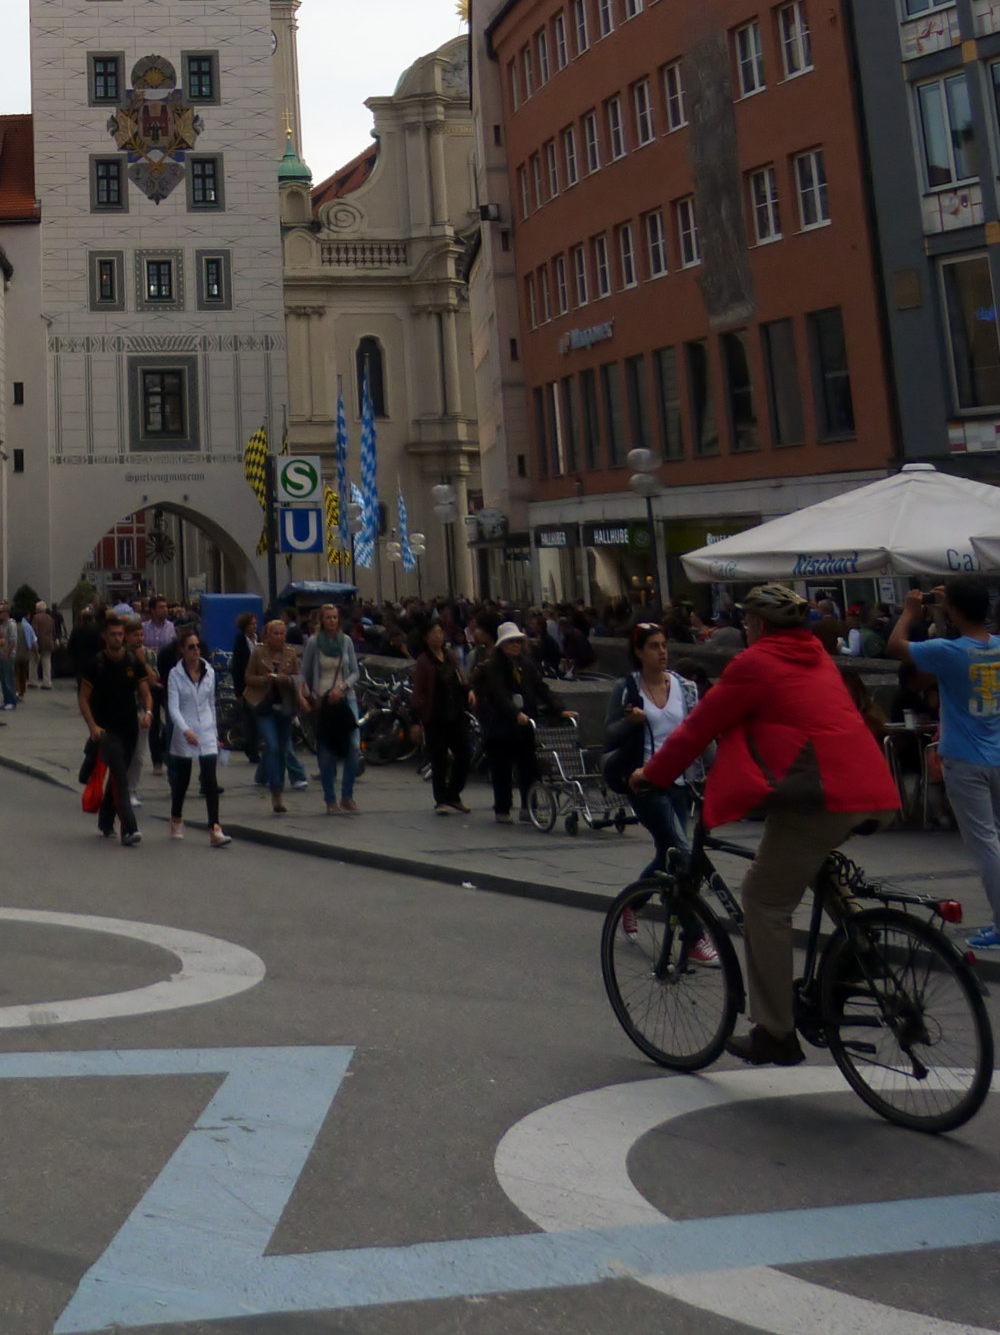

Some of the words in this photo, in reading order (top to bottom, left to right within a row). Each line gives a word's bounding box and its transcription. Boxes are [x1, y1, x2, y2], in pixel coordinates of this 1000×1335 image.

[286, 462, 313, 496] S
[285, 511, 317, 550] U
[593, 528, 630, 544] HALLHUBE
[946, 548, 981, 572] Ca
